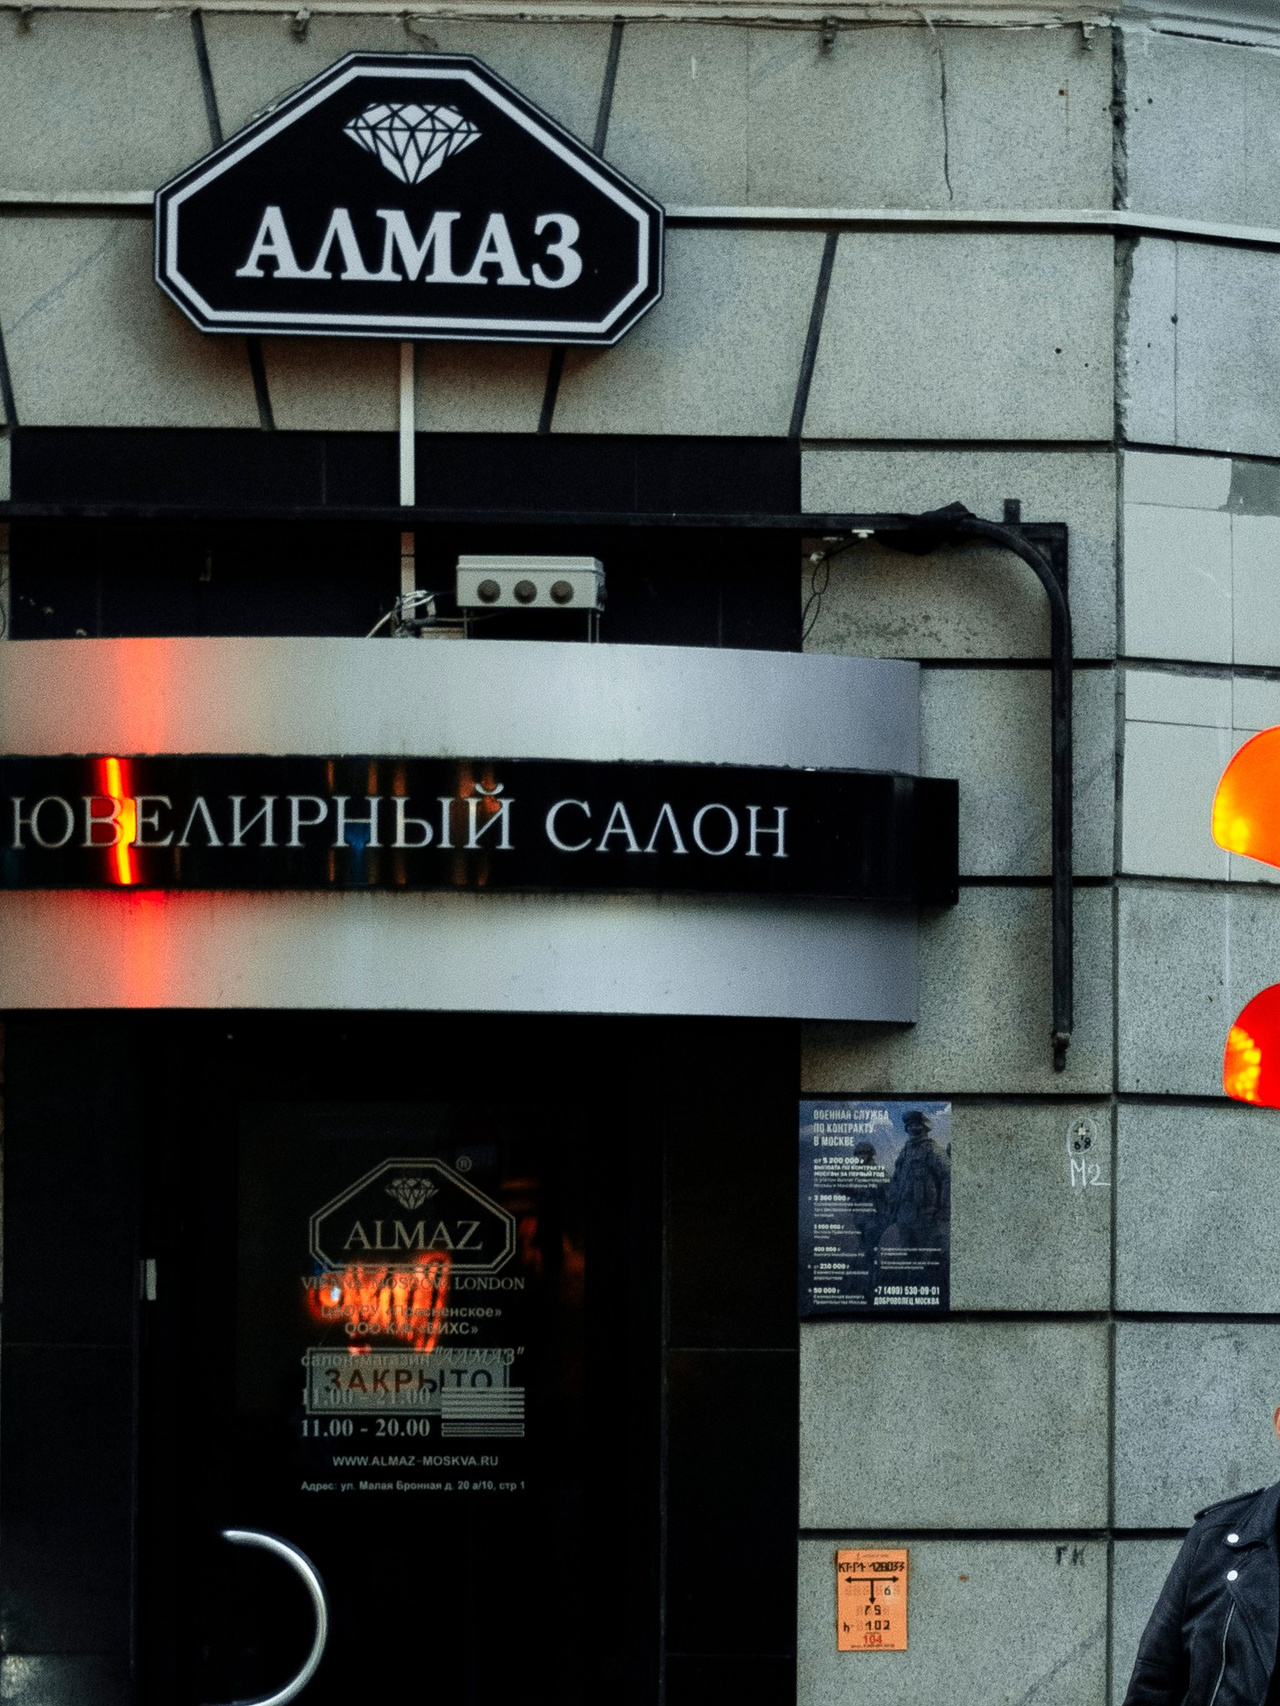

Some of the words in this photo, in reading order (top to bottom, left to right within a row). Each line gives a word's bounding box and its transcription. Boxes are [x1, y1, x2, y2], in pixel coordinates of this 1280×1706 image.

[235, 205, 583, 290] АЛМАЗ
[10, 782, 515, 850] ЮВЕЛИРНЫЙ
[545, 799, 789, 858] САЛОН
[813, 1109, 851, 1121] ВОЕННАЯ
[853, 1109, 889, 1121] СЛУЖБА
[813, 1122, 825, 1134] ПО
[827, 1122, 875, 1134] КОНТРАКТУ
[813, 1136, 819, 1147] В
[821, 1136, 855, 1147] МОСКВЕ
[343, 1219, 484, 1251] ALMAZ
[454, 1276, 525, 1291] LONDON
[874, 1286, 883, 1295] +7
[324, 1369, 494, 1393] ЗАКРЫТО
[301, 1419, 353, 1437] 11.00
[375, 1419, 431, 1437] 20.00
[332, 1455, 499, 1466] WWW.ALMAZ-MOSKVA.RU
[301, 1481, 338, 1491] Адрес:
[359, 1480, 393, 1490] Малая
[396, 1480, 442, 1490] Бронная
[457, 1481, 470, 1490] 20
[499, 1482, 517, 1492] стр
[884, 1585, 891, 1596] 6
